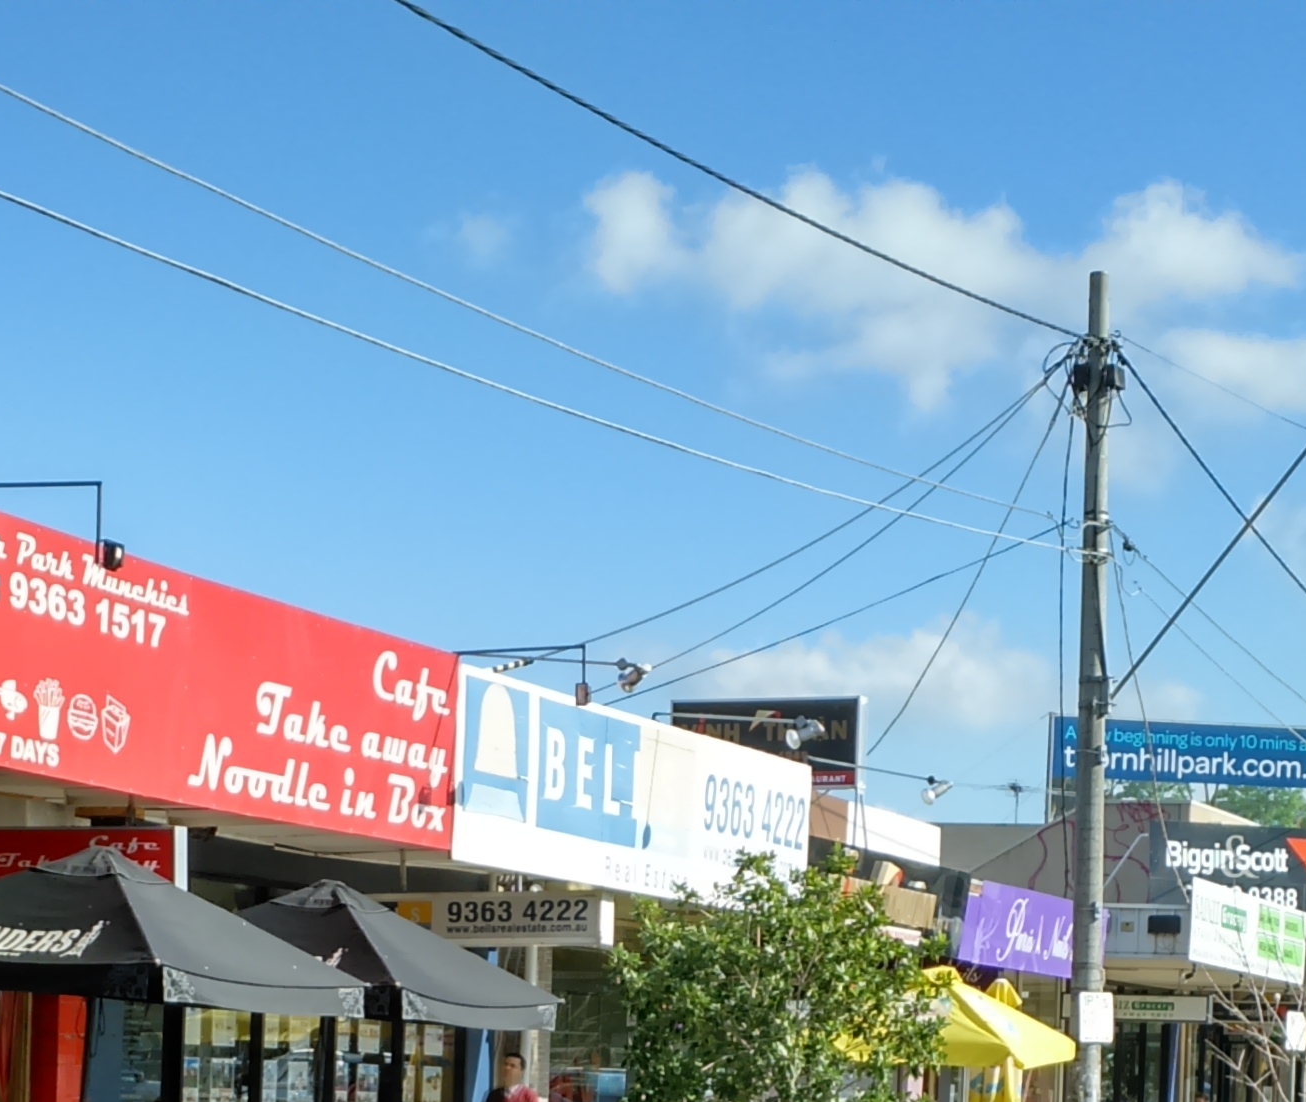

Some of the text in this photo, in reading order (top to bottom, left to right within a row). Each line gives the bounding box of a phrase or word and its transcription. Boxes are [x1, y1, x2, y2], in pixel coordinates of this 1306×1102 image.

[9, 571, 86, 627] 9363
[94, 603, 166, 647] 1517
[16, 532, 74, 583] Park
[82, 554, 190, 617] Munchies
[372, 651, 450, 721] Cafe
[10, 735, 60, 768] DAYS
[255, 680, 448, 789] Take away
[1064, 726, 1076, 740] A
[1117, 730, 1188, 750] beginning
[1191, 734, 1202, 747] is
[1205, 735, 1238, 751] only
[1240, 735, 1257, 749] 10
[1260, 738, 1297, 751] mins
[188, 733, 445, 832] Noodle in Box
[703, 774, 806, 850] 9363 4222
[447, 899, 589, 922] 9363 4222
